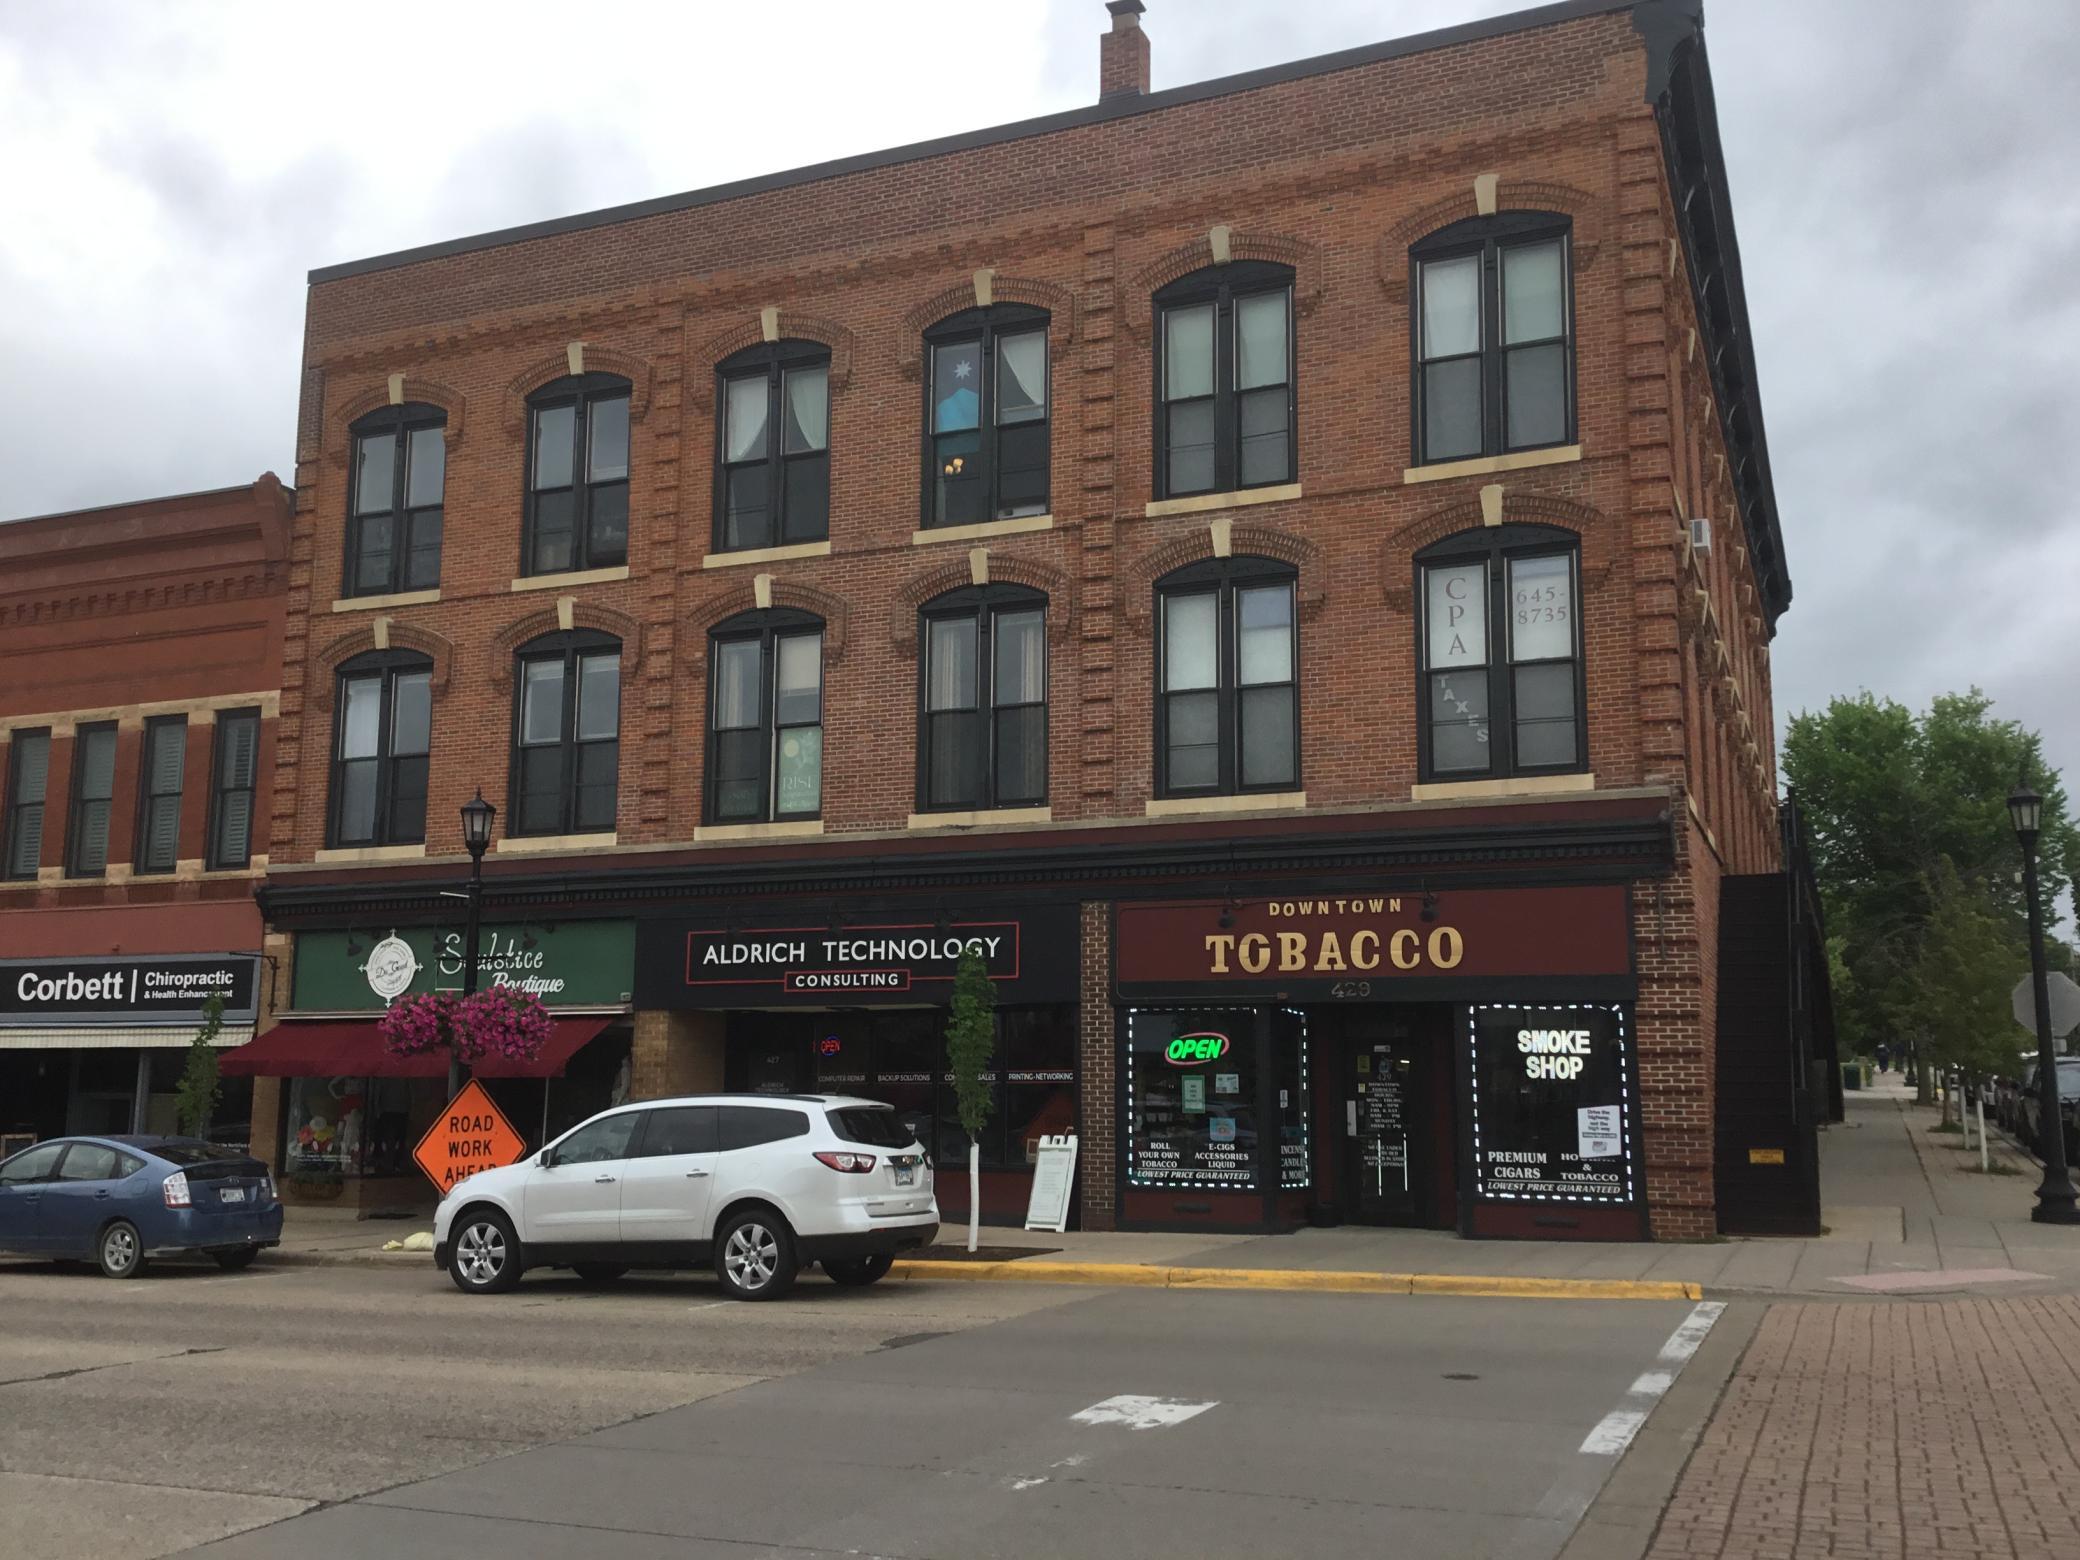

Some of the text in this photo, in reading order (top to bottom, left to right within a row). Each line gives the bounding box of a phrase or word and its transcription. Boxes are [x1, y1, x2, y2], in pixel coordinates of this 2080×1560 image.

[1445, 577, 1467, 655] CPA
[1518, 605, 1567, 625] 8735
[1437, 675, 1489, 743] TAXES
[1268, 898, 1401, 917] DOWNTOWN
[440, 931, 544, 975] Sulstice
[703, 936, 1001, 965] ALDRICH TECHNOLOGY
[1205, 926, 1464, 974] TOBACCO
[18, 970, 124, 1001] Corbett
[145, 970, 234, 989] Chiropractic
[492, 971, 565, 999] Boutique
[795, 973, 899, 988] CONSULTING
[144, 989, 233, 999] & Health Enhancnt
[1331, 981, 1371, 999] 429
[820, 1039, 840, 1053] OPEN
[1168, 1039, 1223, 1060] OPEN
[1517, 1029, 1591, 1055] SMOKE
[1526, 1055, 1584, 1080] SHOP
[847, 1074, 866, 1082] REPAIR
[878, 1074, 930, 1082] BACKUP SOLUTIONS
[977, 1073, 996, 1081] SALES
[449, 1115, 494, 1133] ROAD
[448, 1139, 492, 1158] WORK
[1150, 1142, 1170, 1150] ROLL
[1209, 1143, 1235, 1151] E-CIGS
[1138, 1151, 1180, 1159] YOUR OWN
[1194, 1152, 1249, 1161] ACCESSORIES
[1488, 1151, 1547, 1164] PREMIUM
[1141, 1160, 1178, 1168] TOBACCO
[1208, 1160, 1236, 1169] LIQUID
[1582, 1163, 1592, 1172] &
[444, 1163, 497, 1184] AHE
[1137, 1170, 1250, 1180] LOWEST PRICE GUARANTEED
[1494, 1166, 1541, 1179] CIGARS
[1560, 1172, 1619, 1182] TOBACCO
[1487, 1182, 1621, 1194] LOWEST PRICE GUARANTEED
